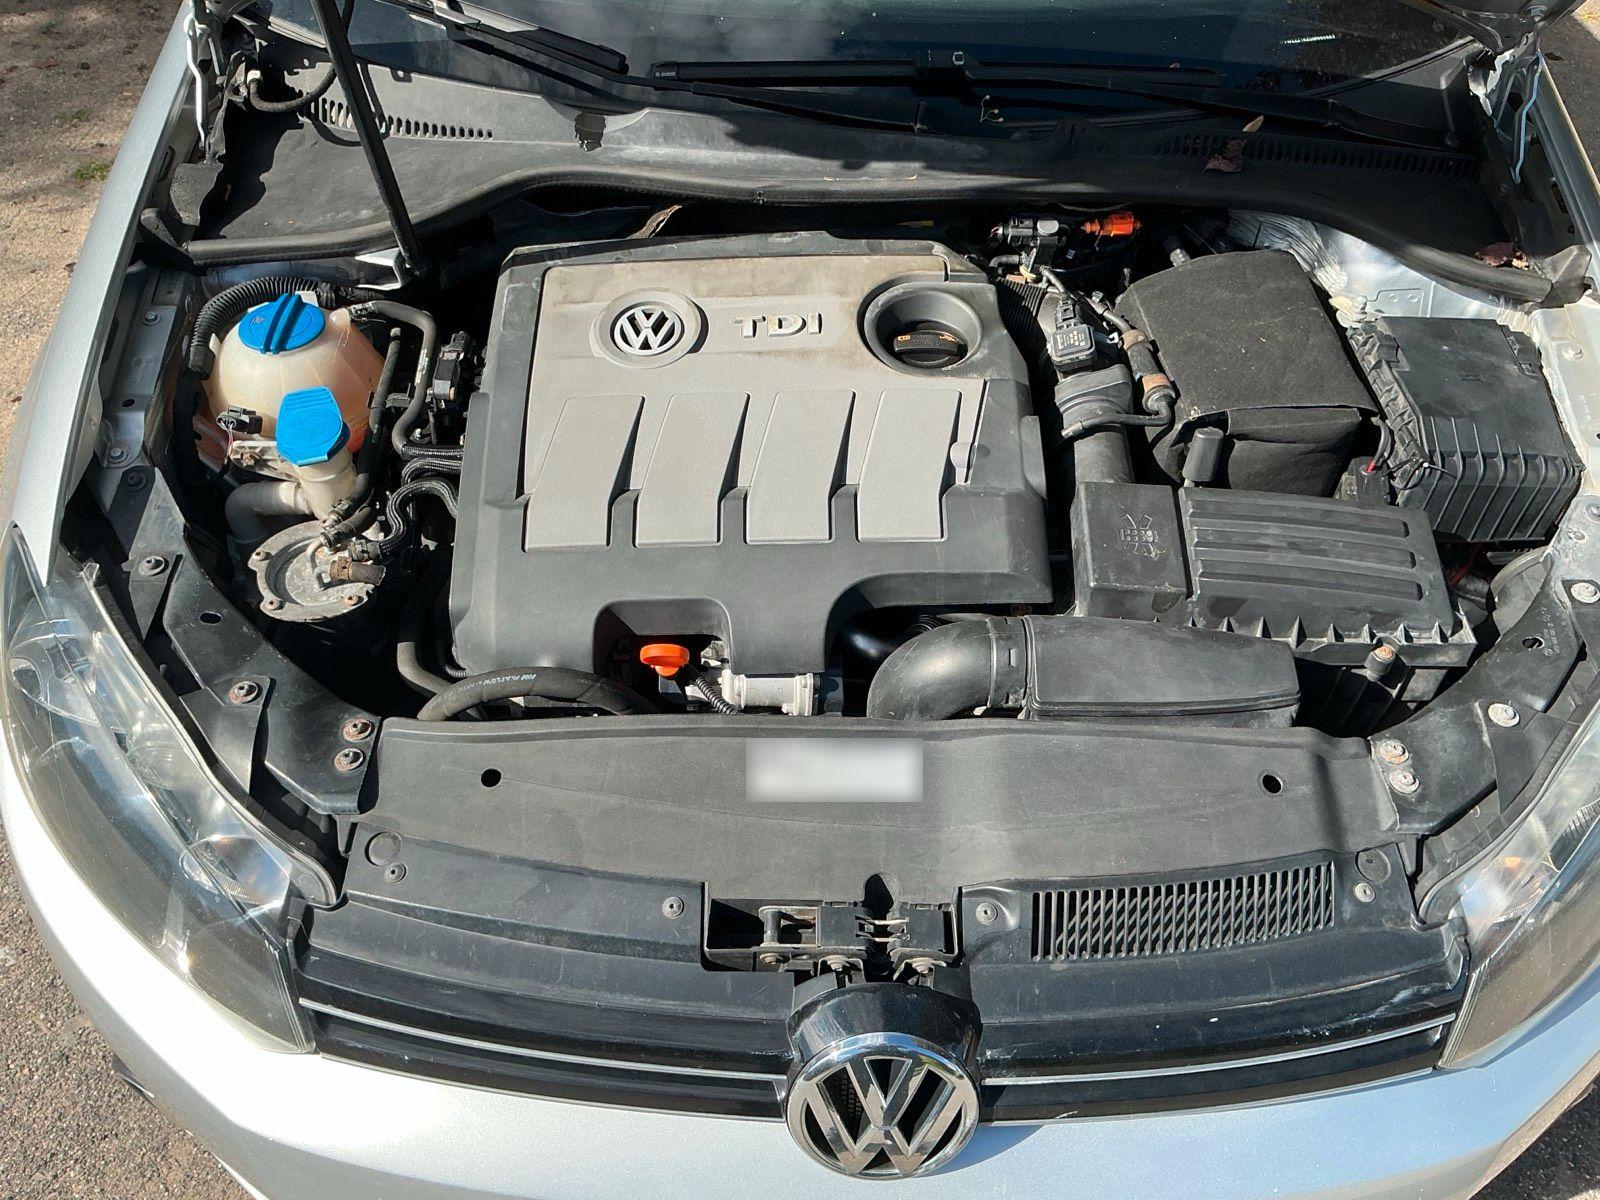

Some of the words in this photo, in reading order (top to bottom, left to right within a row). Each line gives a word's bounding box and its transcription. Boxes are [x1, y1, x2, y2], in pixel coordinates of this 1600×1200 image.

[613, 305, 682, 356] VW
[733, 312, 823, 338] TDI
[792, 1042, 976, 1178] VW
